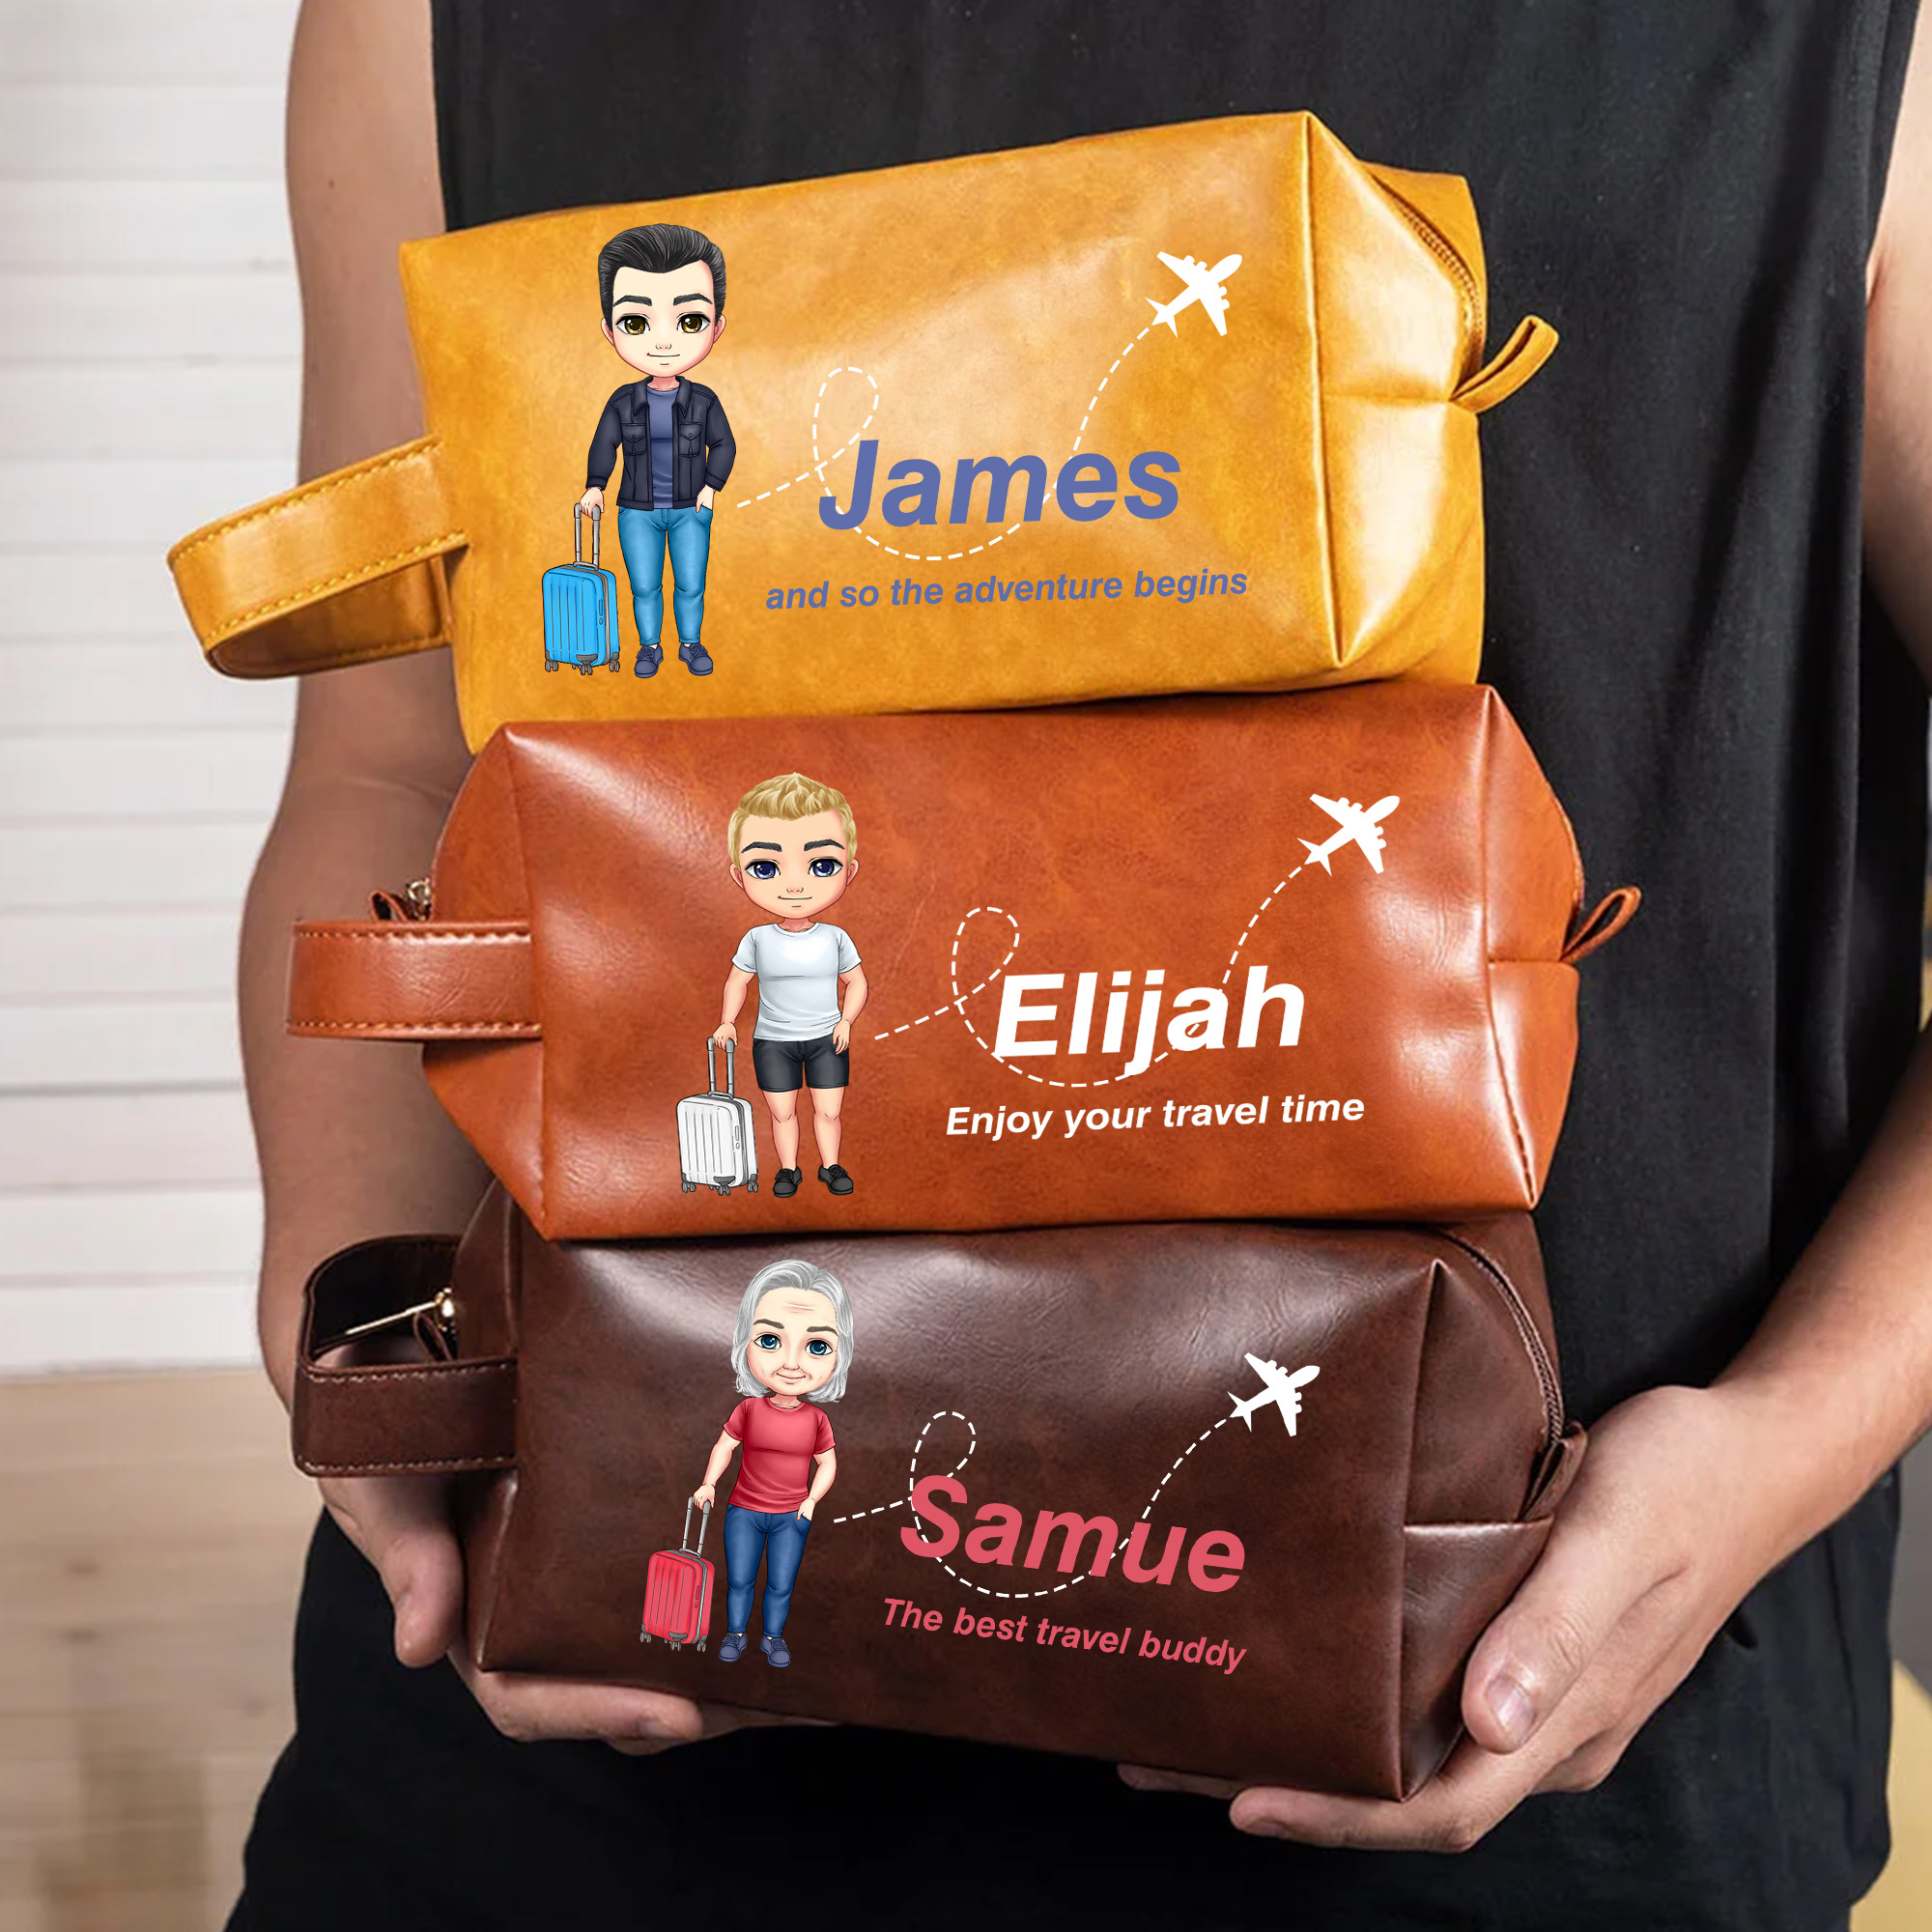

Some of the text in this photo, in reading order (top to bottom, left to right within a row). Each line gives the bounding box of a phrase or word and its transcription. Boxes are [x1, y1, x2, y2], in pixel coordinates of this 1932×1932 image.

[819, 440, 1180, 530] James
[766, 568, 1247, 611] and so the adventure begins
[994, 966, 1304, 1076] Elijah
[946, 1094, 1364, 1142] Enjoy your travel time
[900, 1475, 1245, 1592] Samue
[884, 1598, 1247, 1675] The best travel buddy
